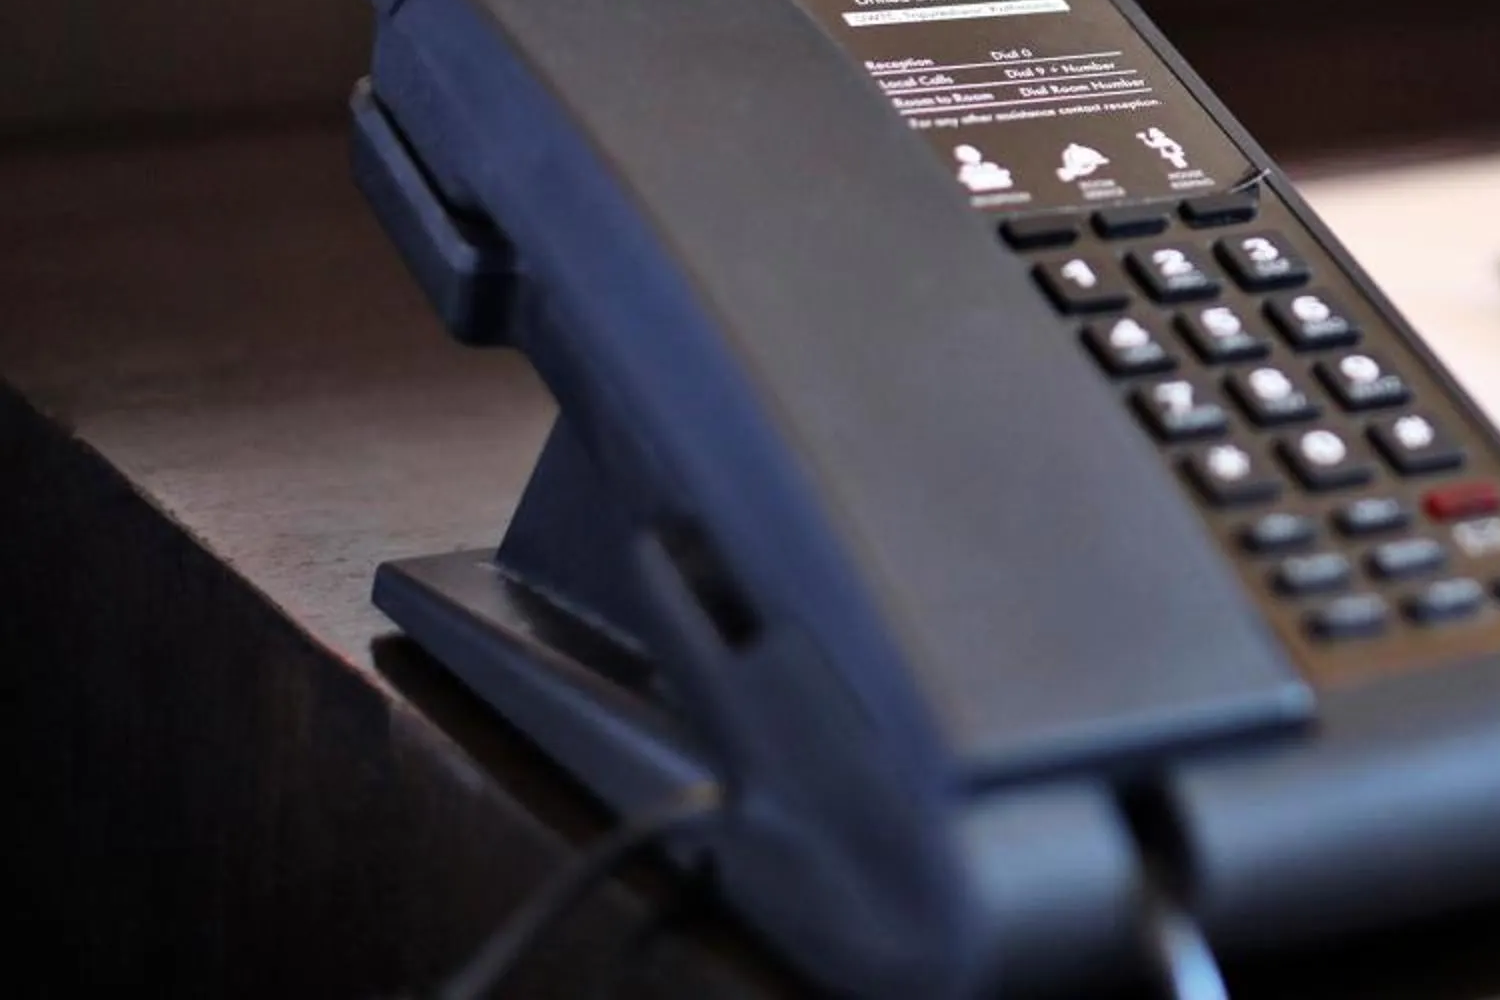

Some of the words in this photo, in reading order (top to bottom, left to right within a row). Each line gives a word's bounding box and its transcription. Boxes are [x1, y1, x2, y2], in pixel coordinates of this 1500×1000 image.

[863, 57, 935, 71] Reception
[990, 49, 1020, 61] Dial
[918, 74, 955, 86] Calls
[1003, 66, 1035, 79] Dial
[1061, 61, 1116, 74] Number
[952, 92, 996, 103] Room
[1018, 85, 1049, 98] Dial
[1049, 83, 1092, 95] Room
[1090, 77, 1146, 91] Number
[1242, 237, 1279, 261] 3
[1060, 258, 1097, 289] 1
[1152, 248, 1194, 277] 2
